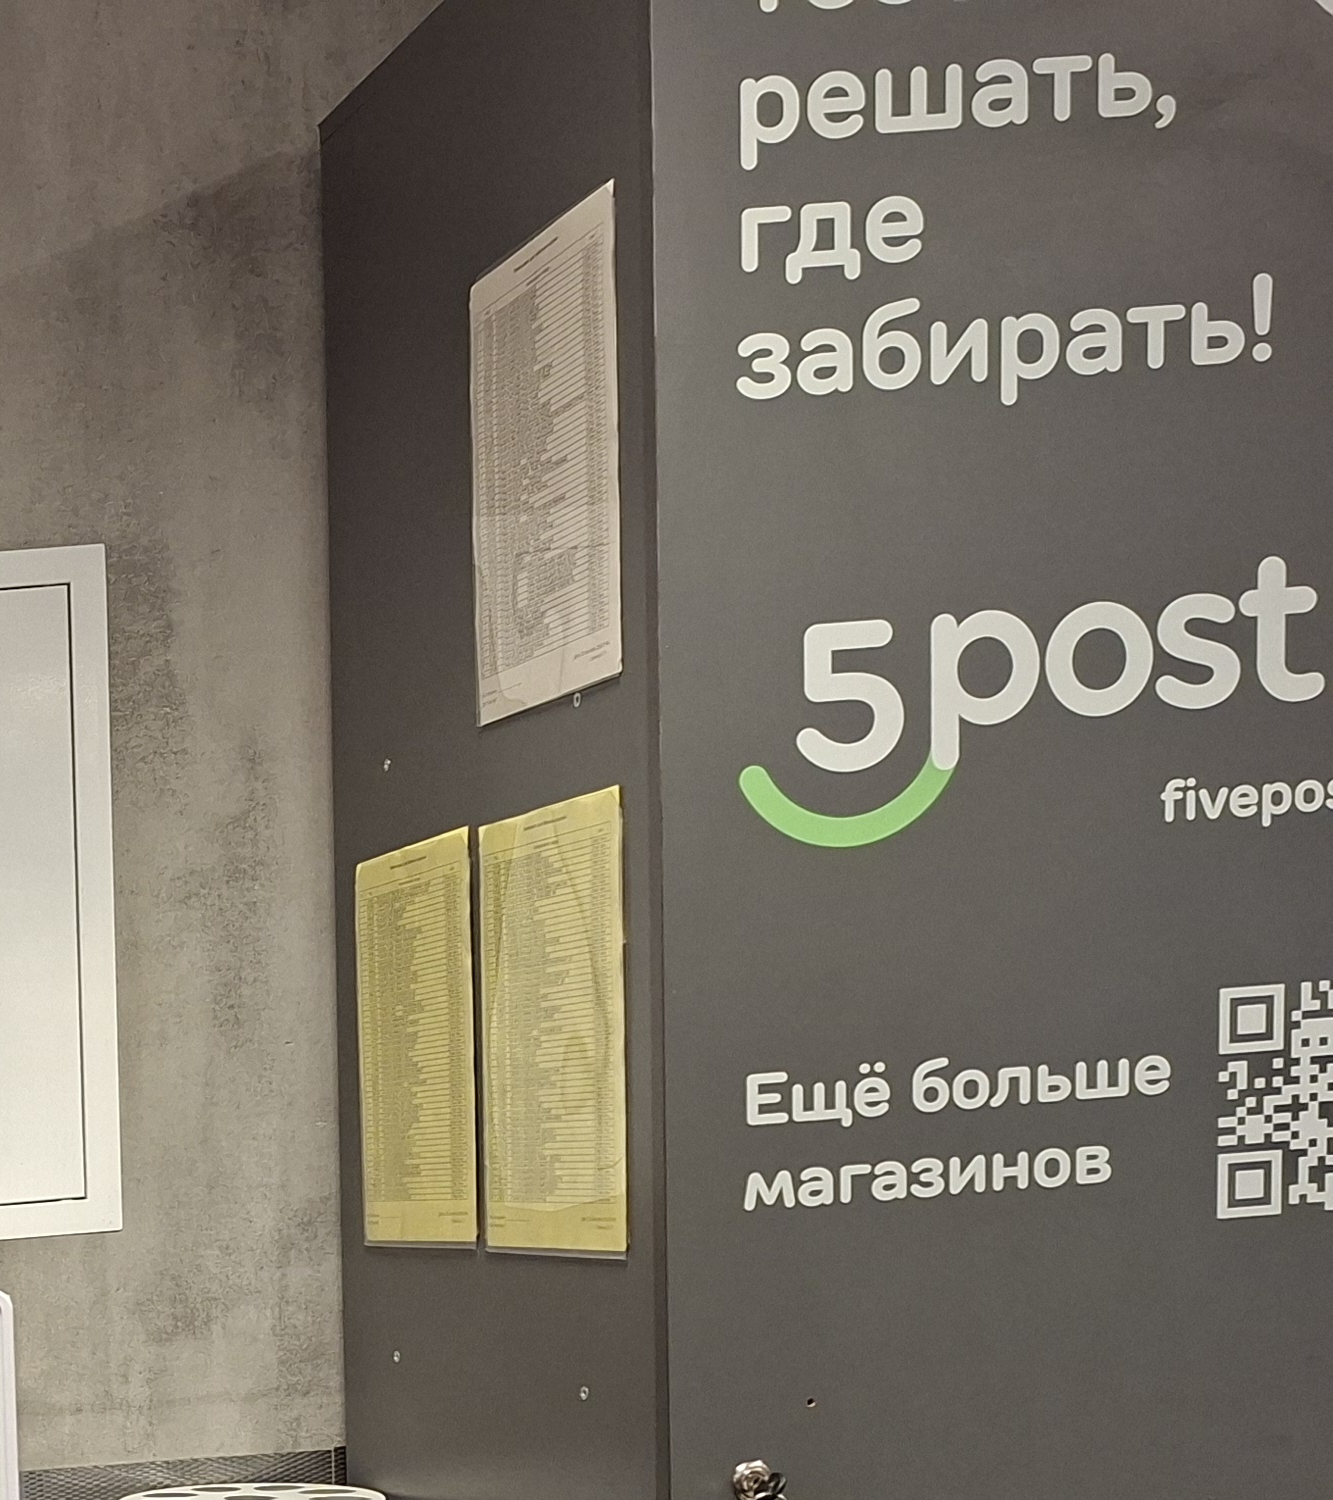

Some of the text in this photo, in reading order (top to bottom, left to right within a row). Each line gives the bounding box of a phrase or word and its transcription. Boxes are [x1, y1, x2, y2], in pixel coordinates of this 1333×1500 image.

[739, 52, 1177, 171] решать,
[740, 195, 925, 284] где
[736, 272, 1274, 406] забирать!
[795, 555, 1326, 772] 5post
[744, 1054, 1172, 1128] Ещё больше
[743, 1144, 1113, 1212] магазинов
